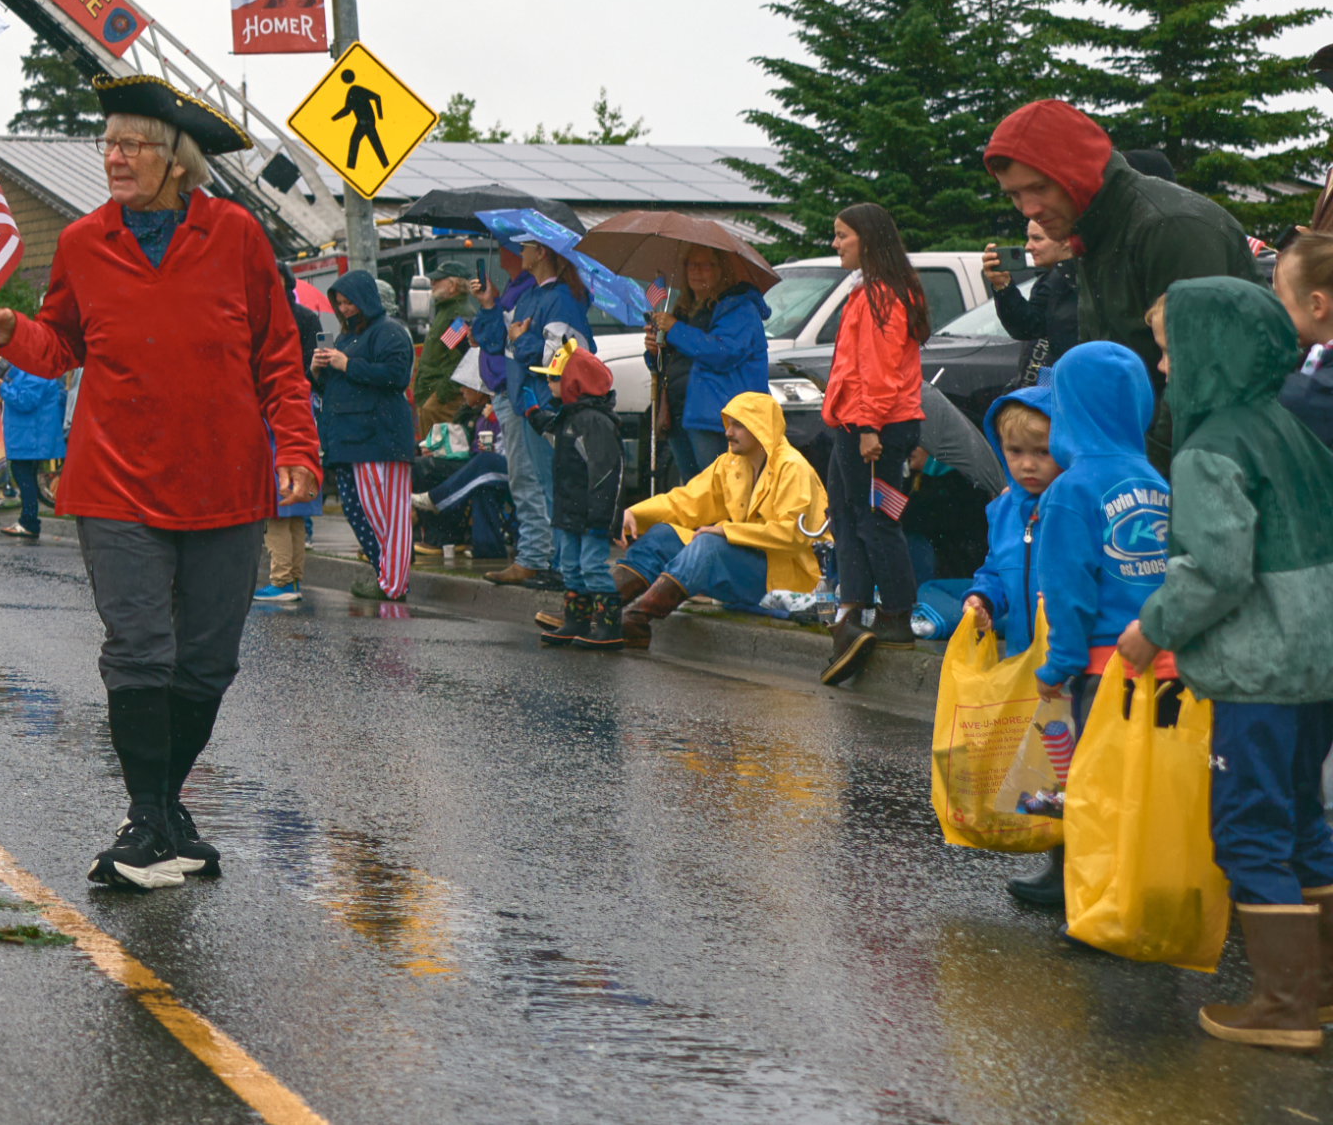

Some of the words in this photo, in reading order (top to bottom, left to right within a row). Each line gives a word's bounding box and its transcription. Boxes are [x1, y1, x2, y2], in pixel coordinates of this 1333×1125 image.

[242, 15, 317, 45] HOMER
[1104, 493, 1135, 522] evin
[1136, 559, 1166, 575] 2005
